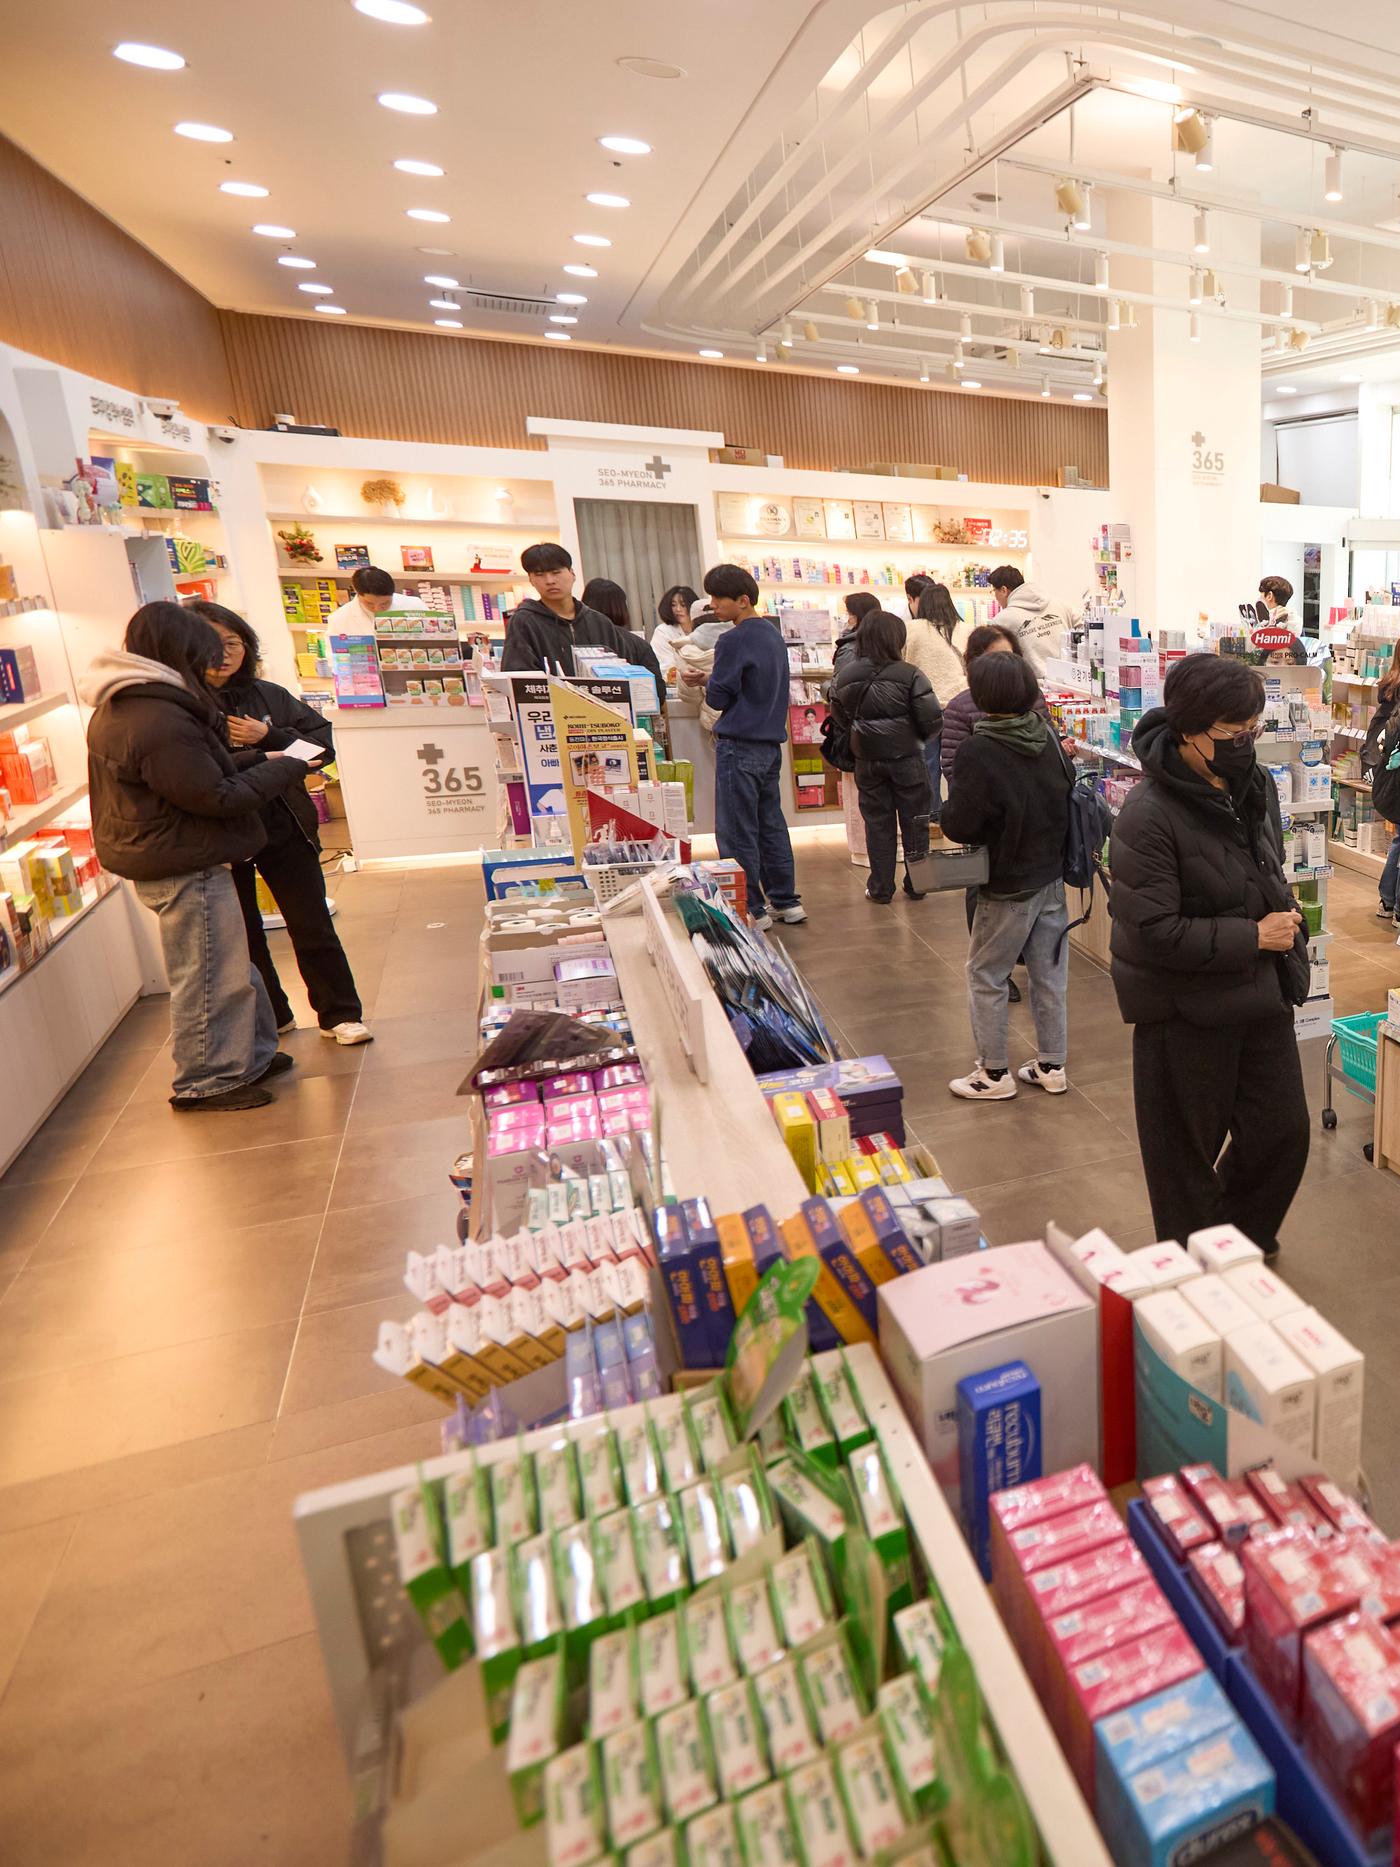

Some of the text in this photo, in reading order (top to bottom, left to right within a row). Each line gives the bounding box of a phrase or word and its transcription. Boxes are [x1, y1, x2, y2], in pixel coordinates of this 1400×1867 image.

[1192, 450, 1224, 471] 365
[598, 469, 653, 479] SEO-MYEON
[599, 479, 666, 489] 365 PHARMACY
[1036, 630, 1051, 639] Jeep
[1254, 632, 1291, 645] Hanmi
[591, 684, 622, 695] 솔루션
[422, 767, 483, 793] 365
[443, 806, 485, 814] PHARMACY
[1002, 1402, 1023, 1489] recuburn
